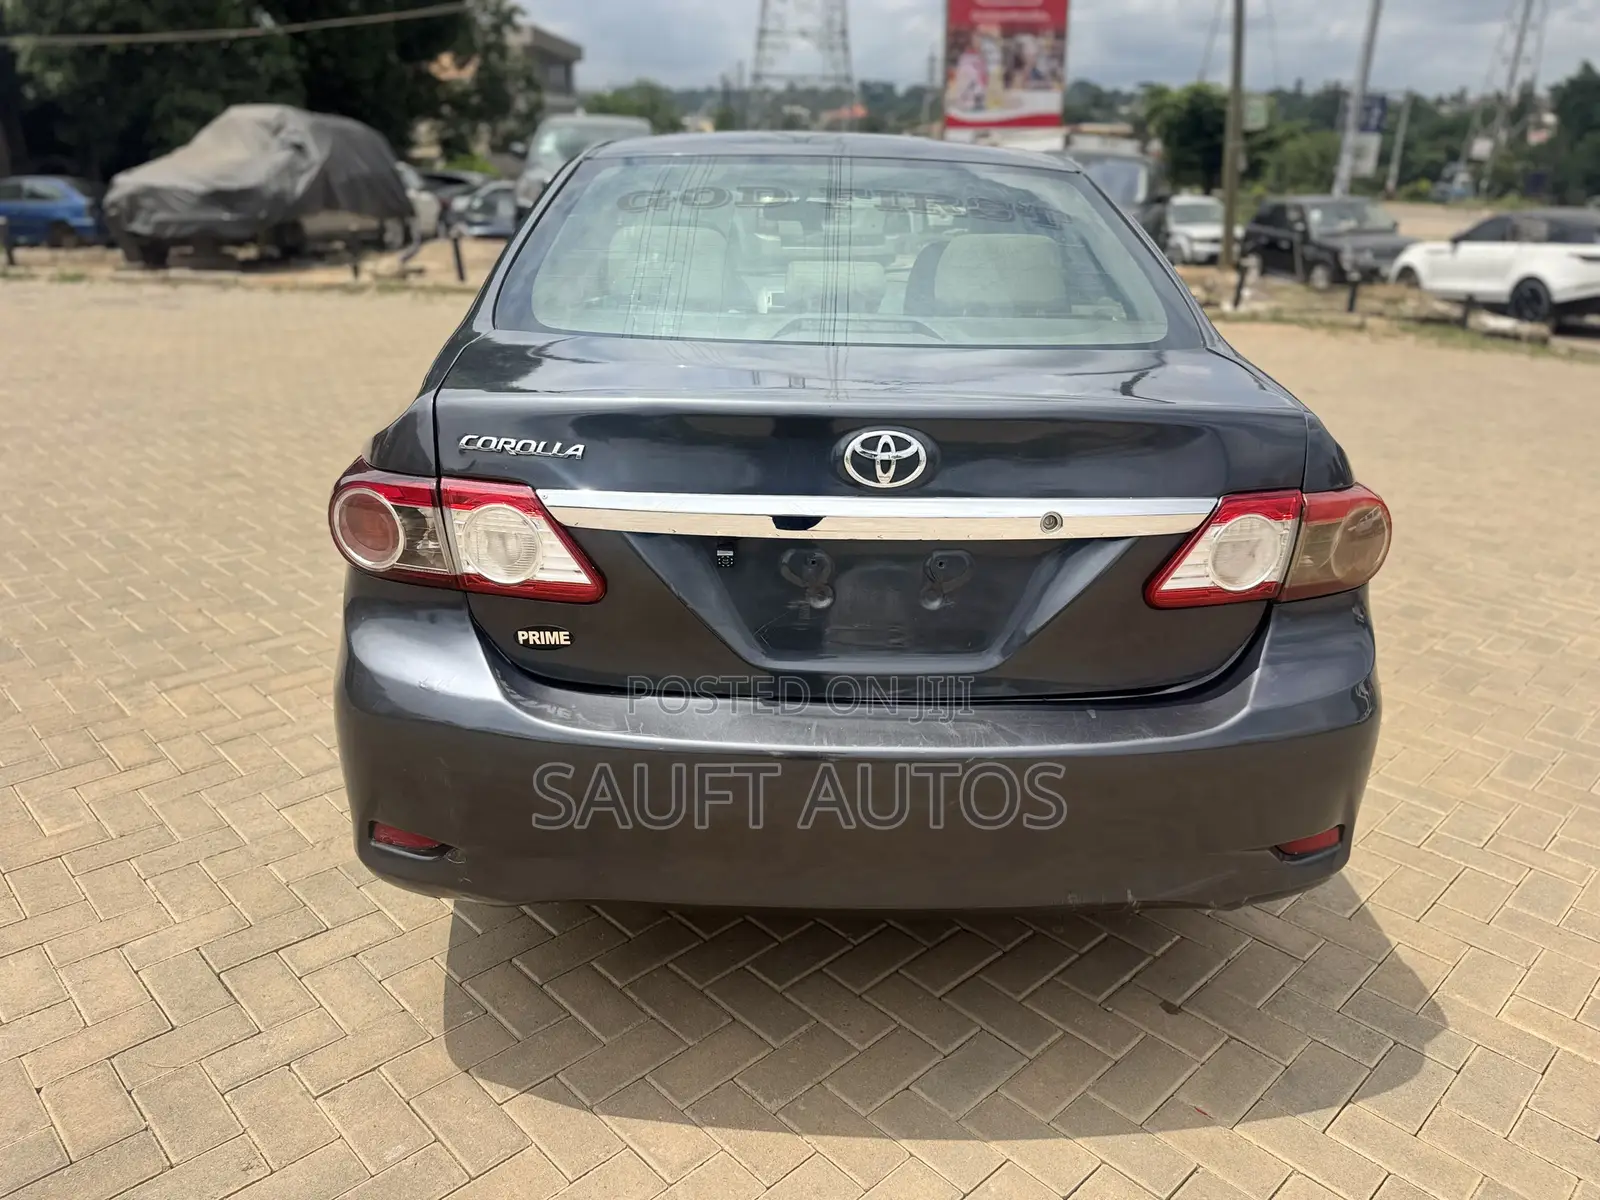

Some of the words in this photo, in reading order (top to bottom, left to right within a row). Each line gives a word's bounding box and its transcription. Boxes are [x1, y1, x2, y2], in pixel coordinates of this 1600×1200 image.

[616, 186, 793, 213] GOD
[458, 434, 585, 460] COROLLA
[517, 630, 571, 645] PRIME
